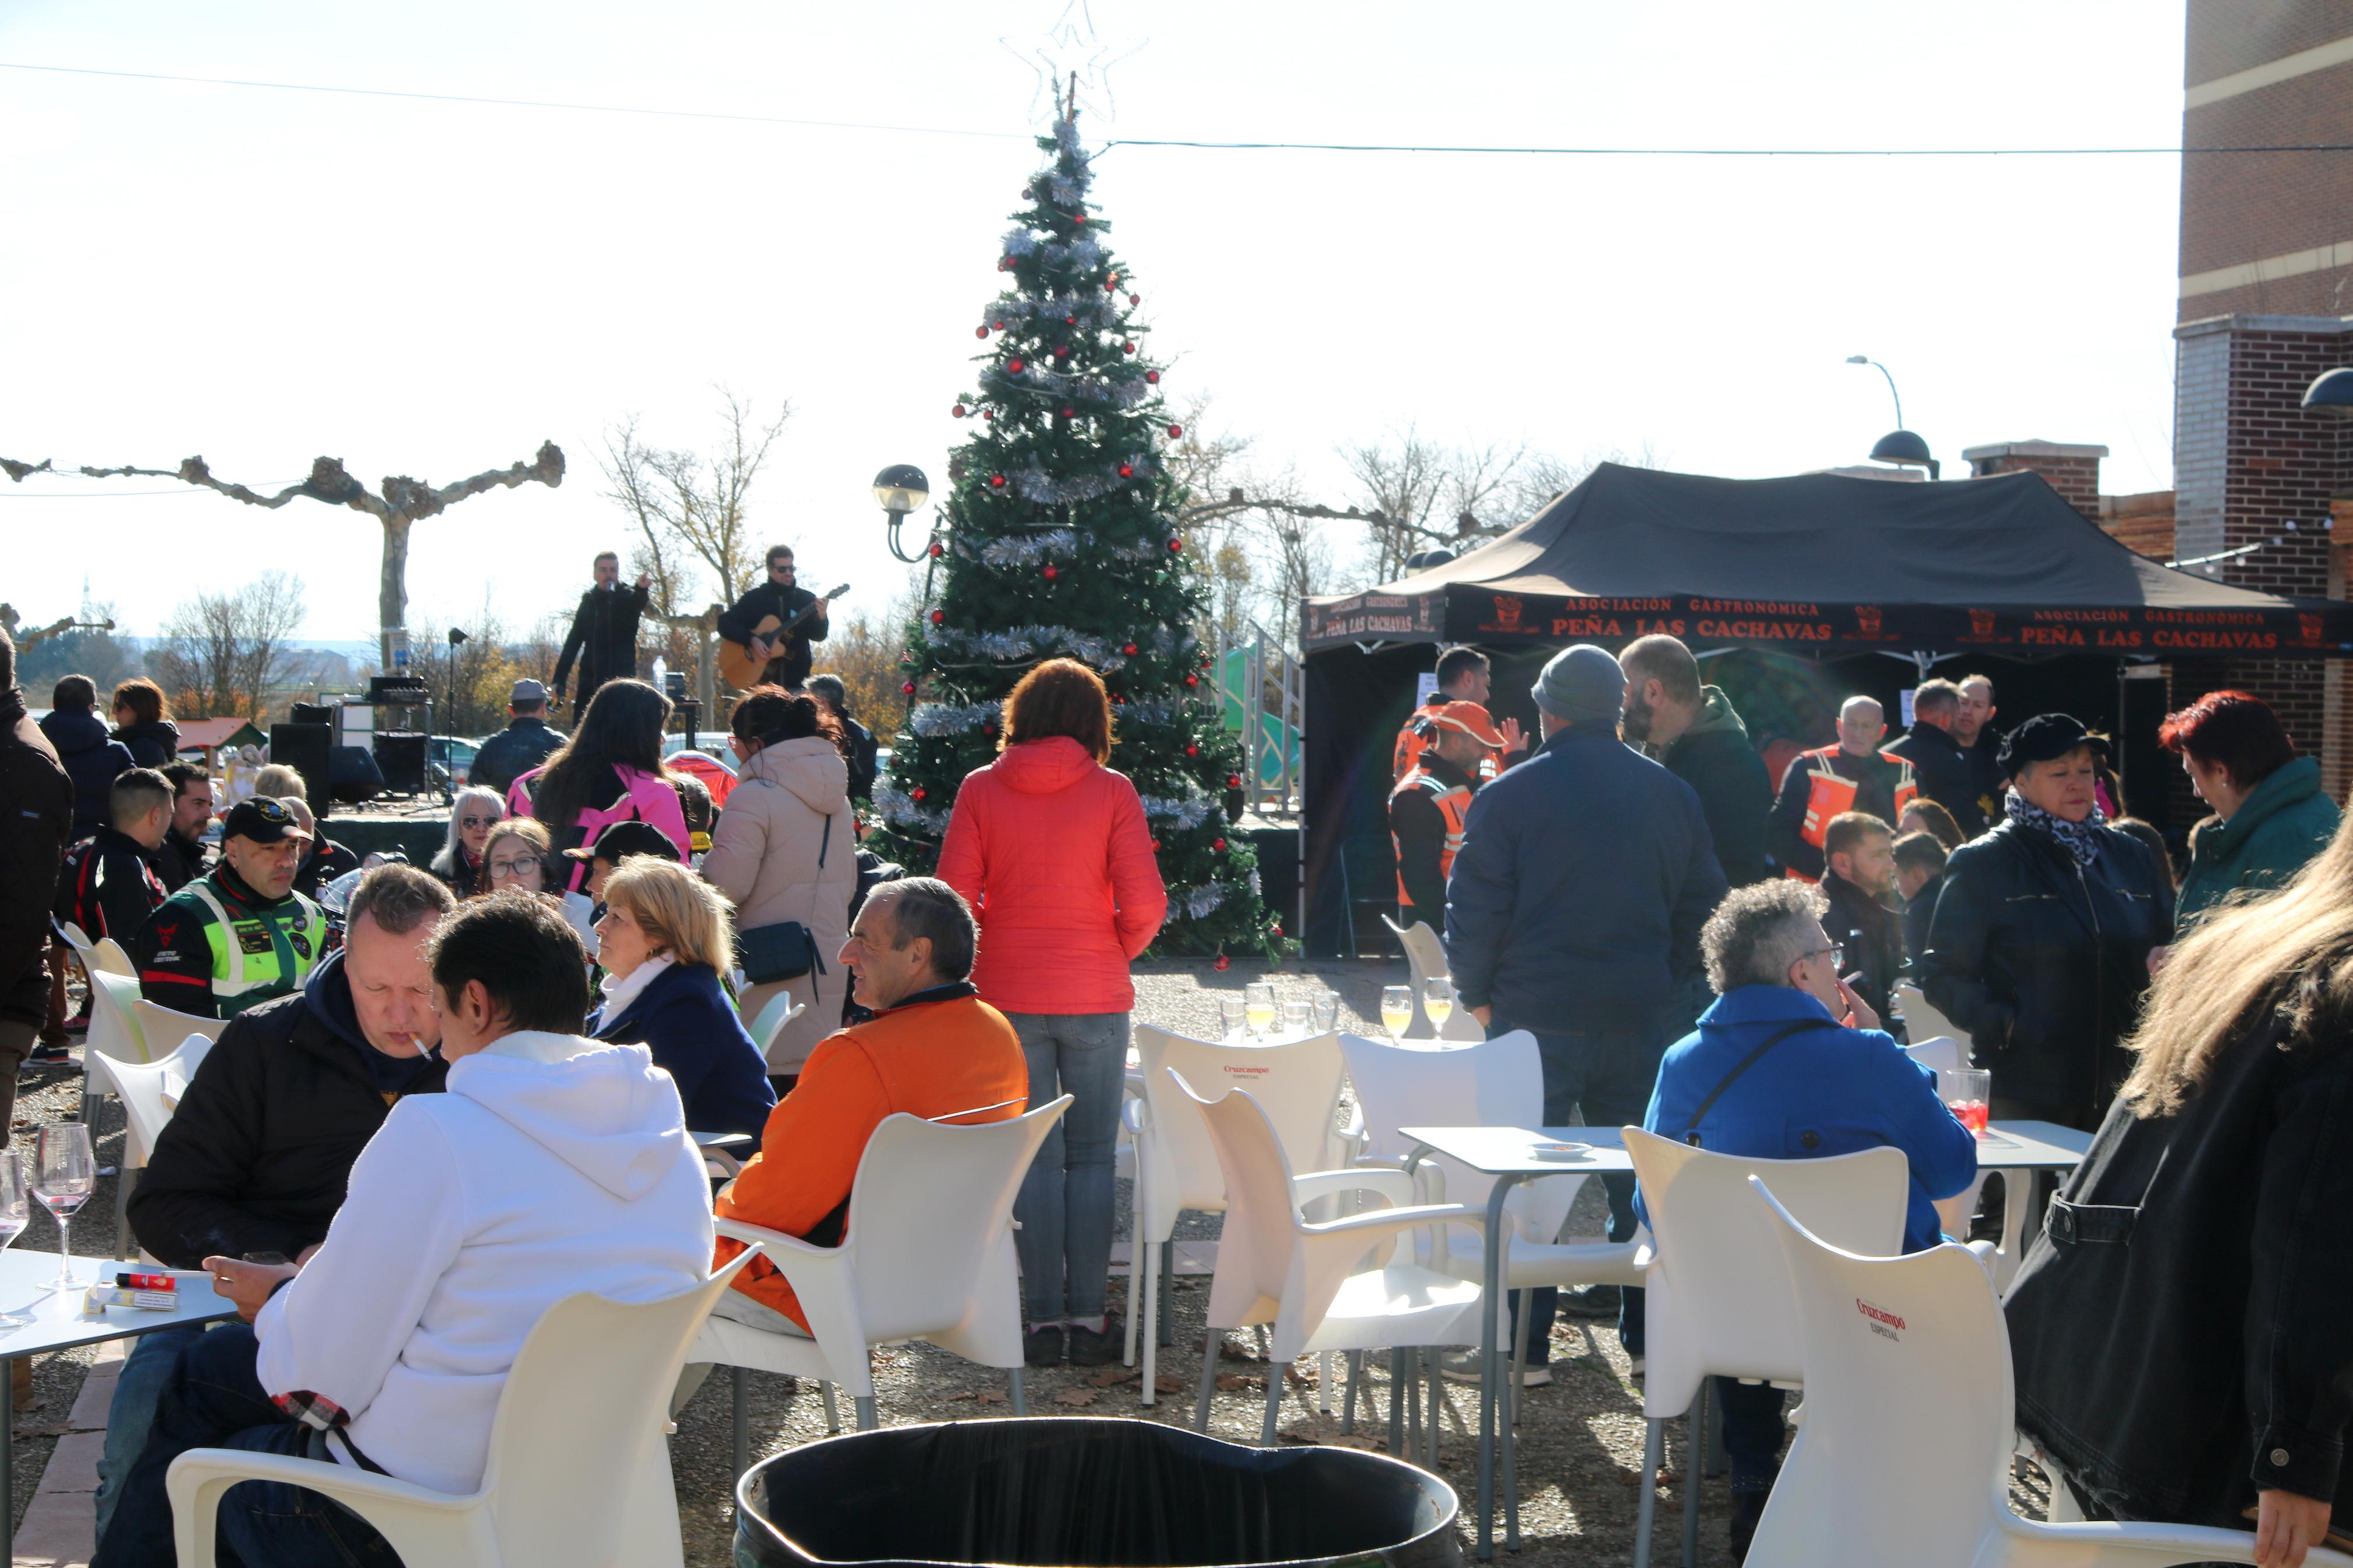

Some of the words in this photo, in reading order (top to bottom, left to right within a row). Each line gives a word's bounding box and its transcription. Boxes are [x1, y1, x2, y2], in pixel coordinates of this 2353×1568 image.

[1566, 596, 1671, 611] ASOCIACIÓN
[1690, 599, 1819, 616] GASTRONÓMICA
[2033, 608, 2129, 623] ASOCIACIÓN
[2145, 609, 2265, 624] GASTRONÓMICA
[1349, 616, 1365, 634] LAS
[1368, 615, 1412, 632] CACHAVAS
[1552, 614, 1623, 636] PEÑA
[1635, 619, 1685, 637] LAS
[1697, 620, 1832, 641] CACHAVAS
[2021, 624, 2086, 646] PEÑA
[2098, 630, 2142, 648] LAS
[2153, 631, 2277, 649] CACHAVAS
[1223, 1065, 1269, 1075] Cruzcampo
[1857, 1298, 1905, 1330] Cruzcampo
[1870, 1322, 1900, 1342] ESPECIAL
